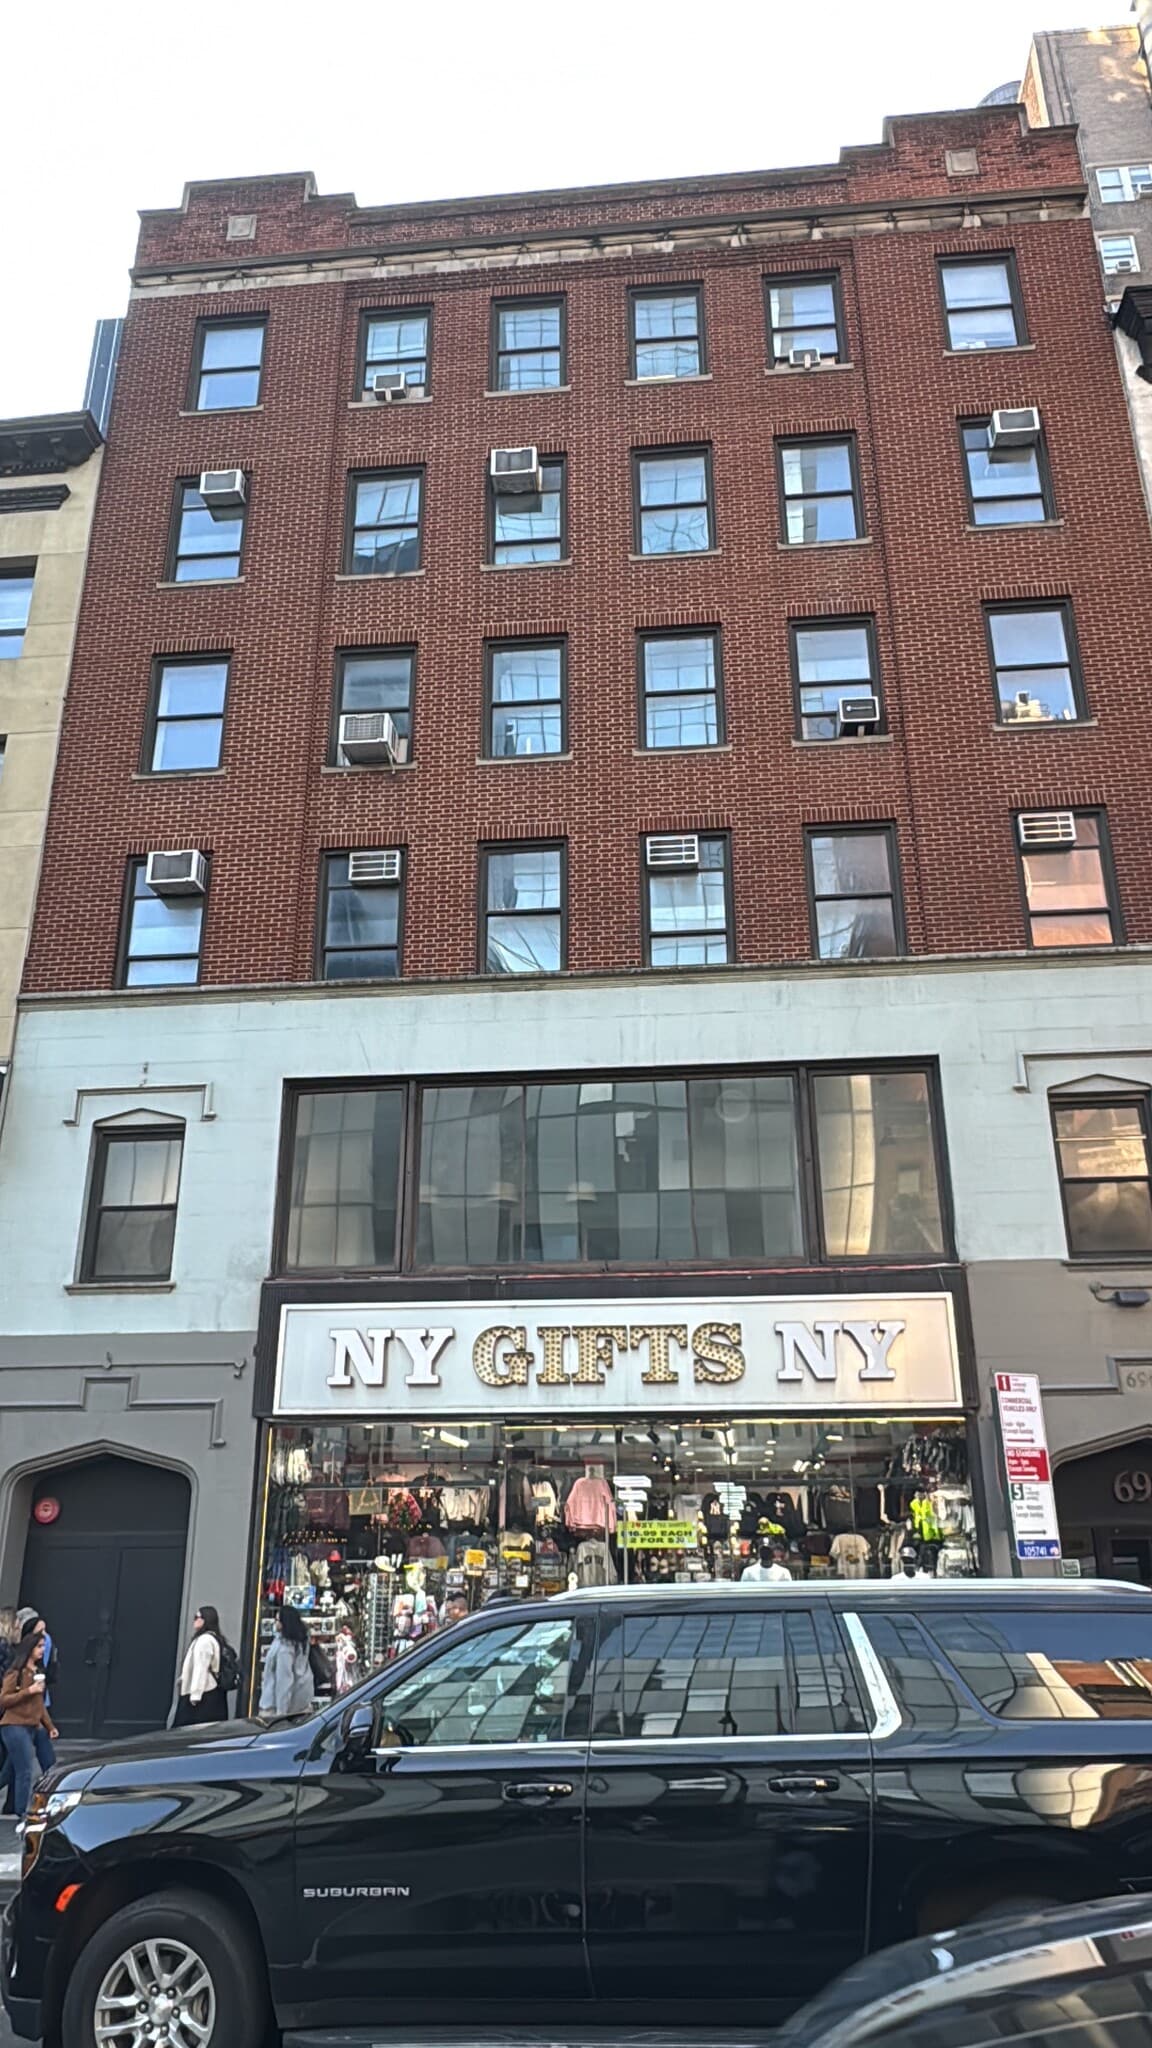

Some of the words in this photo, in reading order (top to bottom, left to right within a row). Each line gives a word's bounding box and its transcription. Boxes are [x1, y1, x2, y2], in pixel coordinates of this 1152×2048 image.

[327, 1327, 454, 1387] NY
[472, 1322, 746, 1386] GIFTS
[774, 1320, 906, 1382] NY
[1013, 1483, 1022, 1500] 5
[303, 1887, 410, 1898] SUBURBAN
